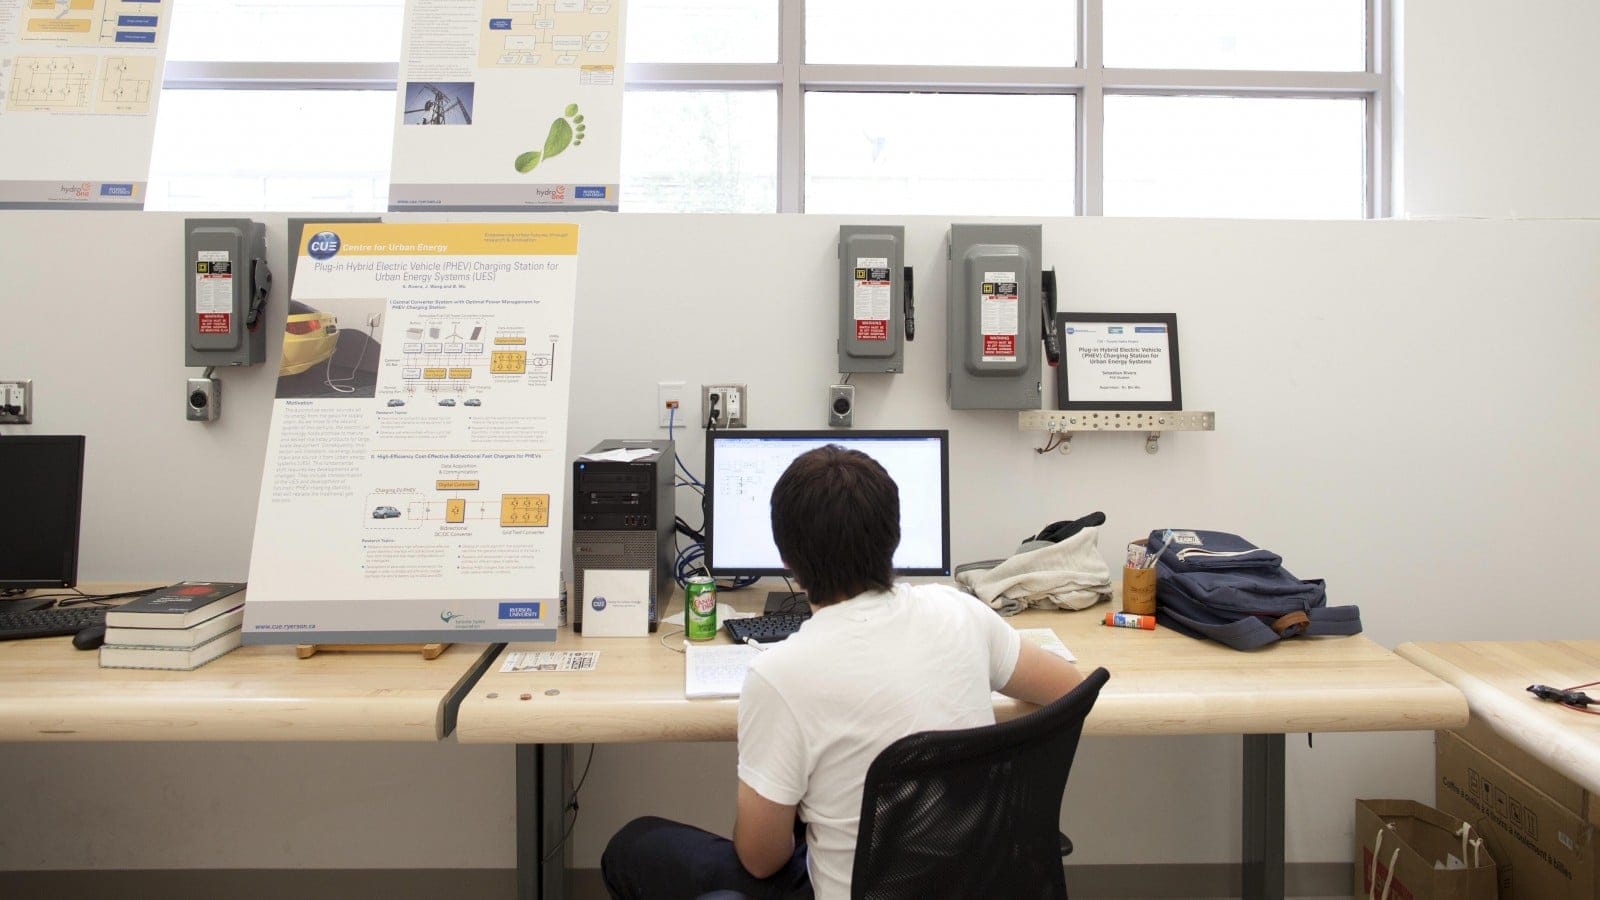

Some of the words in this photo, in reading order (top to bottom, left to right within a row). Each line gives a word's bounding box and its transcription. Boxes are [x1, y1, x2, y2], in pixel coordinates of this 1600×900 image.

[536, 189, 556, 197] hydro
[311, 241, 337, 252] CUE
[342, 243, 372, 251] Centre
[374, 243, 386, 251] for
[418, 243, 448, 252] Energy
[314, 262, 344, 272] Plug-in
[346, 262, 374, 272] Hybrid
[376, 262, 408, 270] Electric
[410, 262, 440, 270] Vehicle
[443, 262, 472, 272] (PHEV)
[473, 262, 511, 272] Charging
[514, 262, 544, 271] Station
[546, 262, 559, 270] for
[375, 272, 400, 280] Urban
[403, 272, 432, 282] Energy
[435, 272, 472, 282] Systems
[472, 272, 496, 282] (UES)
